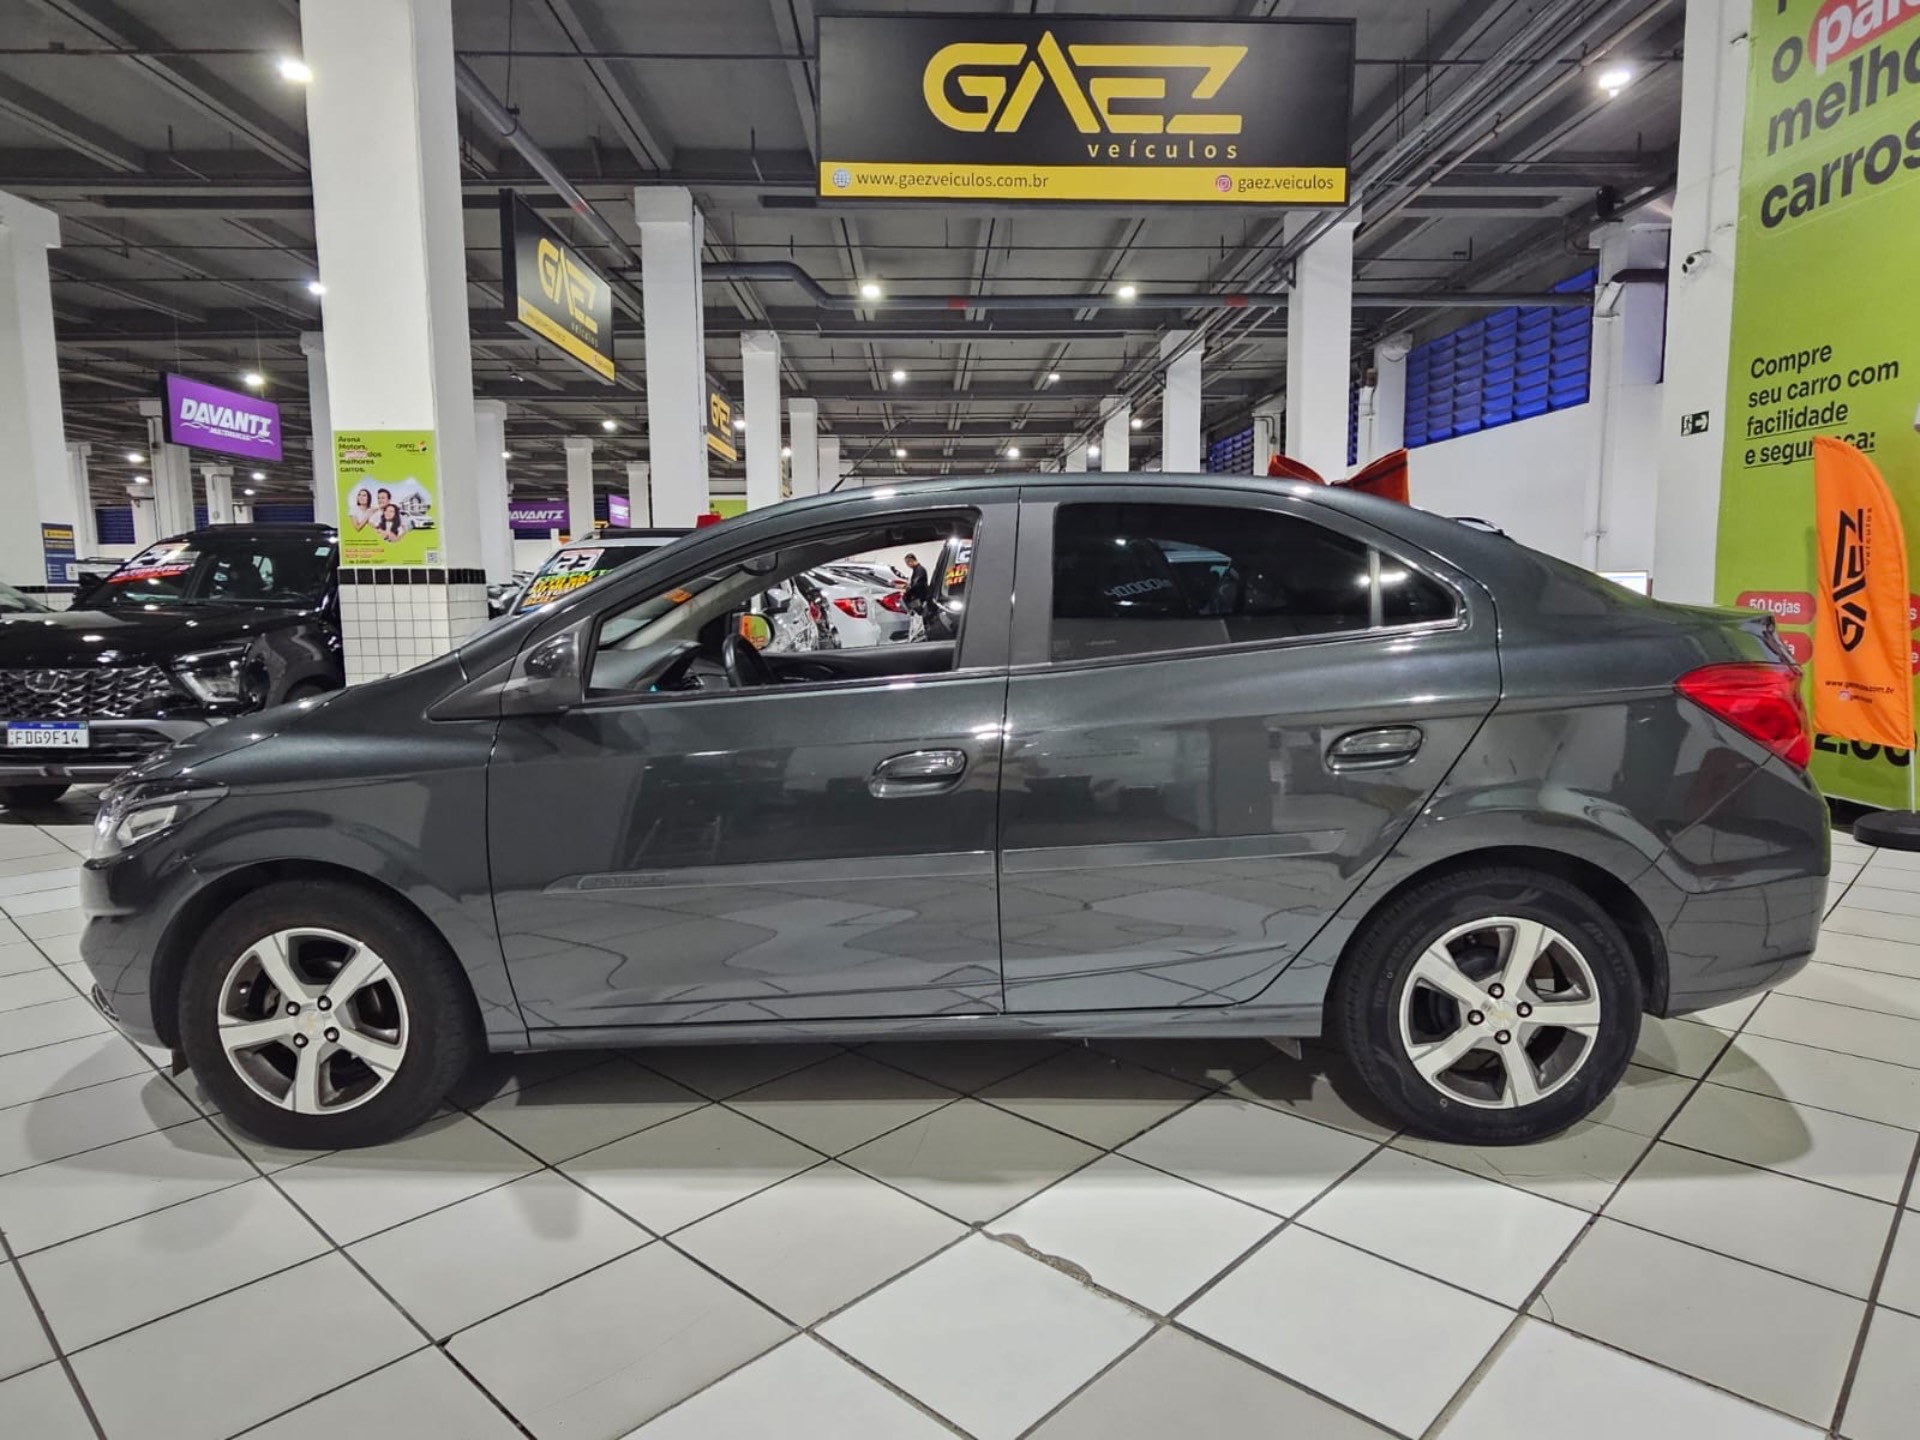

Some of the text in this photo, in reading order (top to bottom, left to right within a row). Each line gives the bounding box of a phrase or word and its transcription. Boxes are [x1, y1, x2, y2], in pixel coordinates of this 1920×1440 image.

[1772, 0, 1920, 84] o pa
[922, 30, 1249, 134] GAEZ
[1087, 139, 1238, 160] veículos
[856, 170, 1049, 190] www.gaezveiculos.com.br
[1237, 174, 1334, 193] gaez.veiculos
[537, 237, 598, 335] GAEZ
[1750, 345, 1832, 379] Compre
[1748, 360, 1899, 408] seu carro com
[180, 397, 273, 438] DAVANTI
[1746, 401, 1849, 438] facilidade
[1744, 431, 1875, 466] e segura:
[509, 509, 565, 520] AVANTI
[1749, 598, 1801, 617] 50 Lojas
[15, 731, 79, 745] FDG9F14
